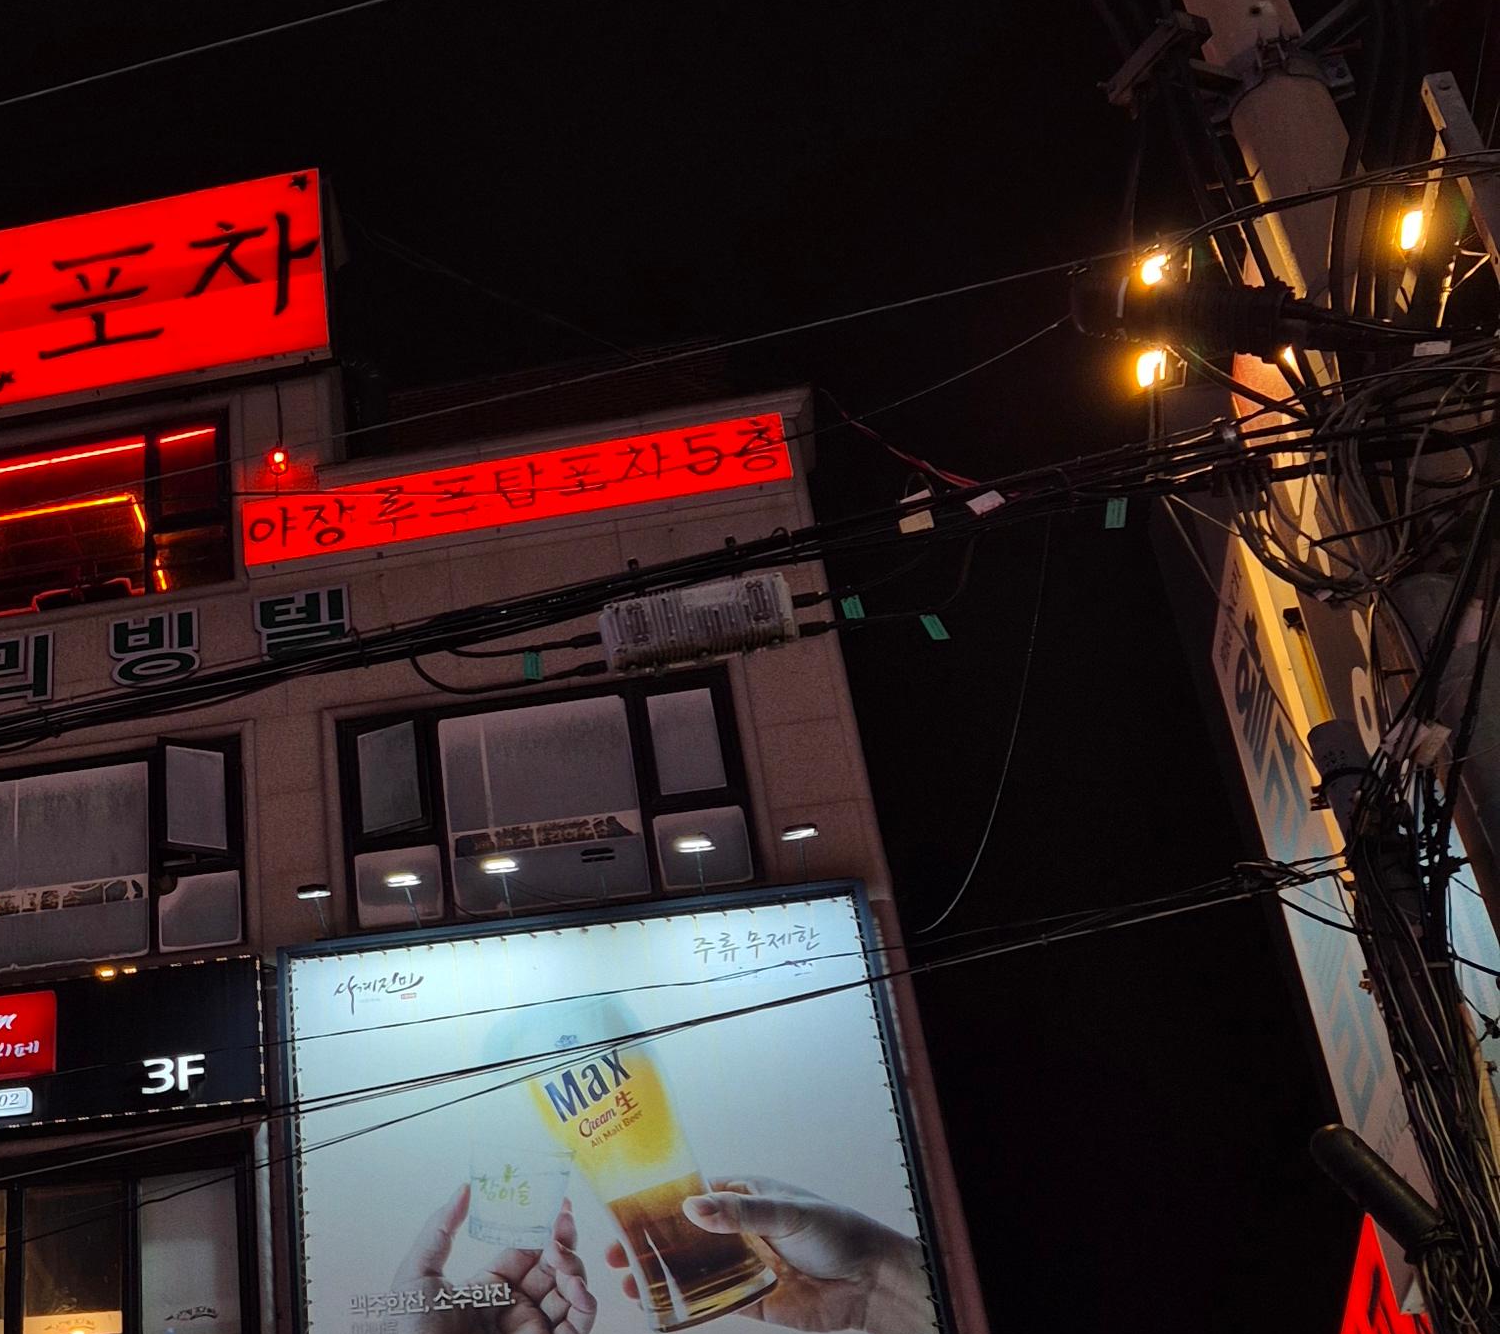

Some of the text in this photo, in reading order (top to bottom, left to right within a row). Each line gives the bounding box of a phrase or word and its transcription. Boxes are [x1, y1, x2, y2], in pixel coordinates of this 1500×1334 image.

[141, 1053, 206, 1095] 3F
[543, 1048, 632, 1123] Max
[579, 1090, 639, 1137] Cream 生
[349, 1282, 516, 1317] 맥주한잔, 소주한잔.
